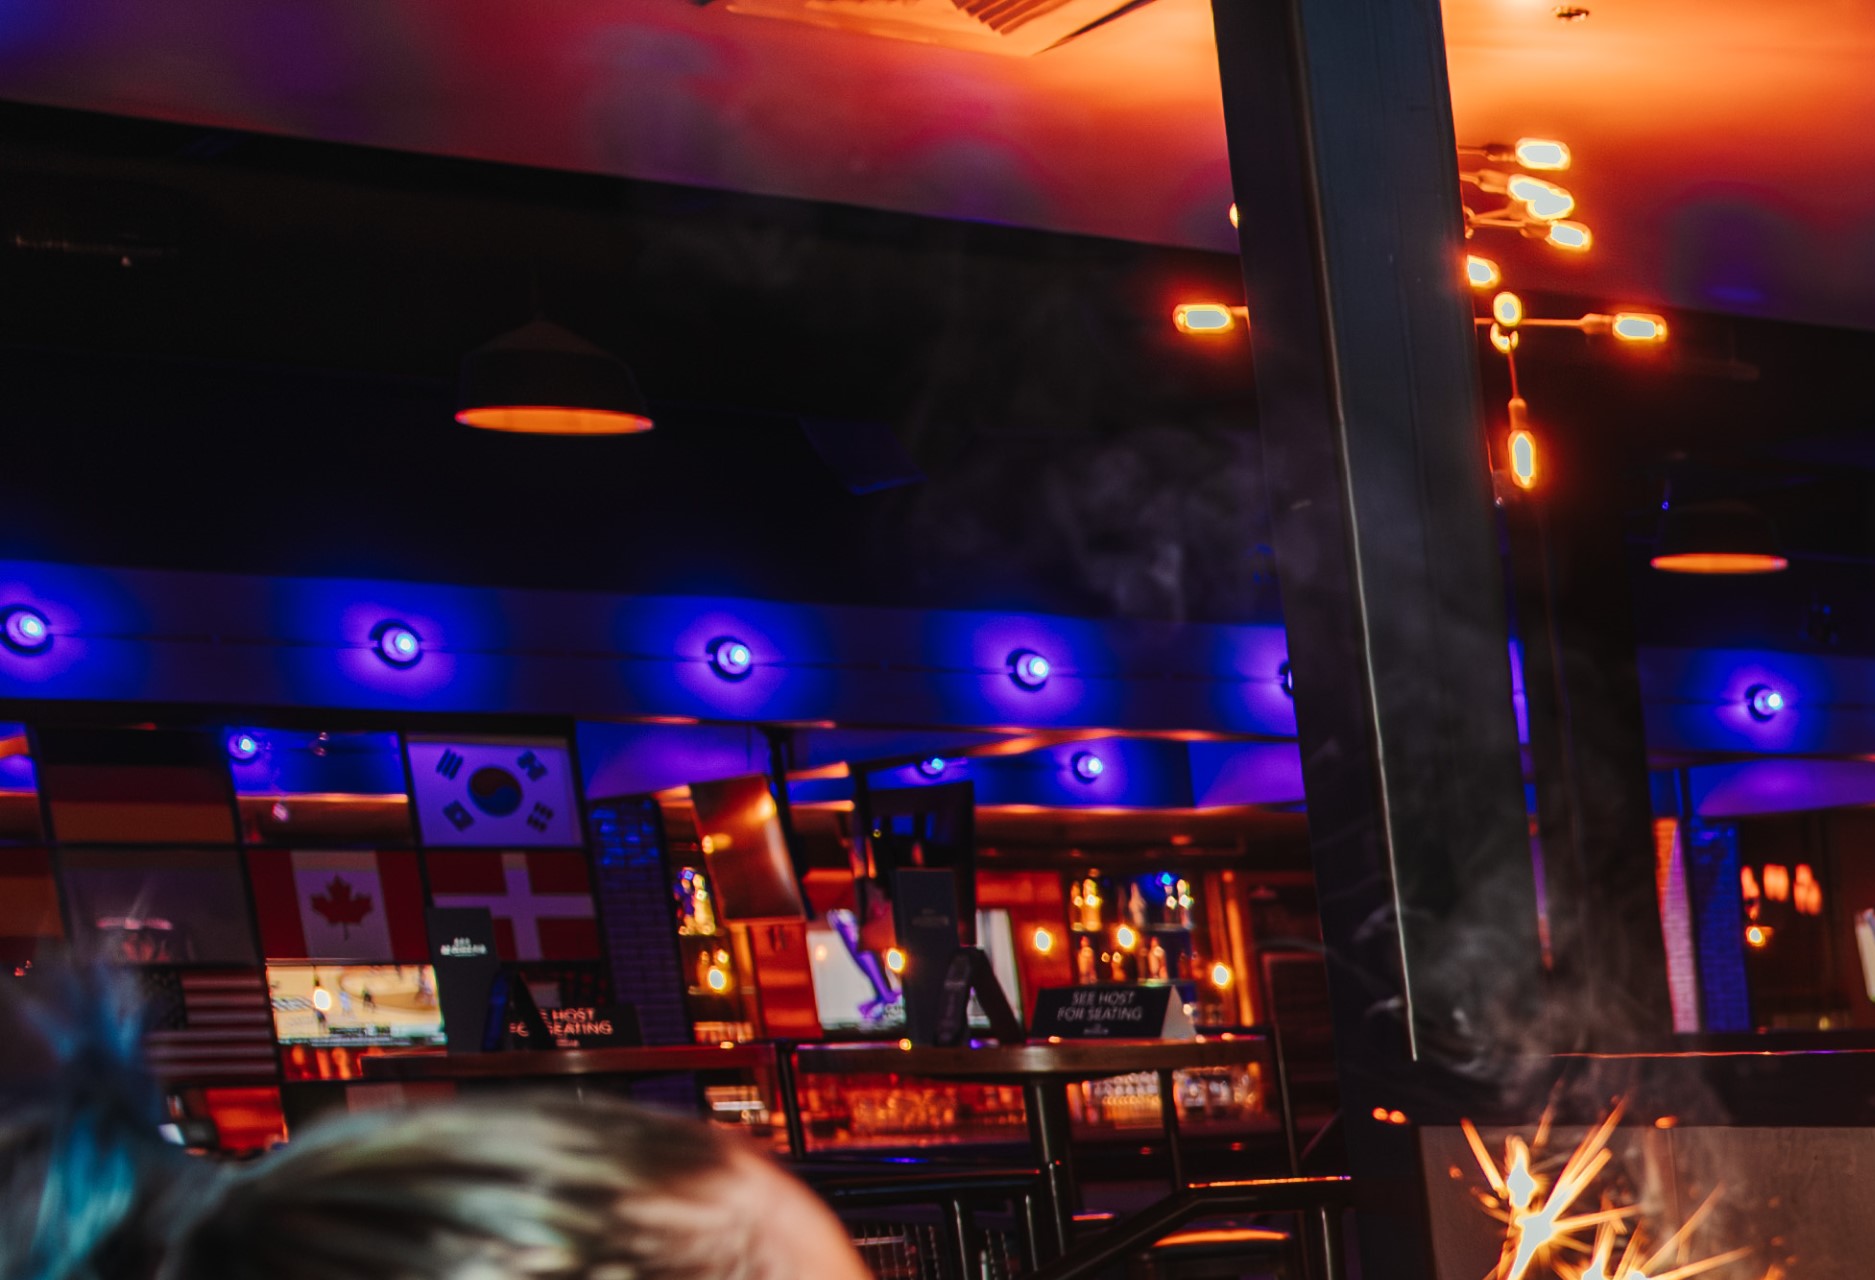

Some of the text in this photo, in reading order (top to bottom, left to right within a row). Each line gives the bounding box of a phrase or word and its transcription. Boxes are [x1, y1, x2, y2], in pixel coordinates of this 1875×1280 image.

[1099, 990, 1135, 1004] HOST
[552, 1008, 595, 1021] HOST
[1087, 1006, 1142, 1021] SEATING
